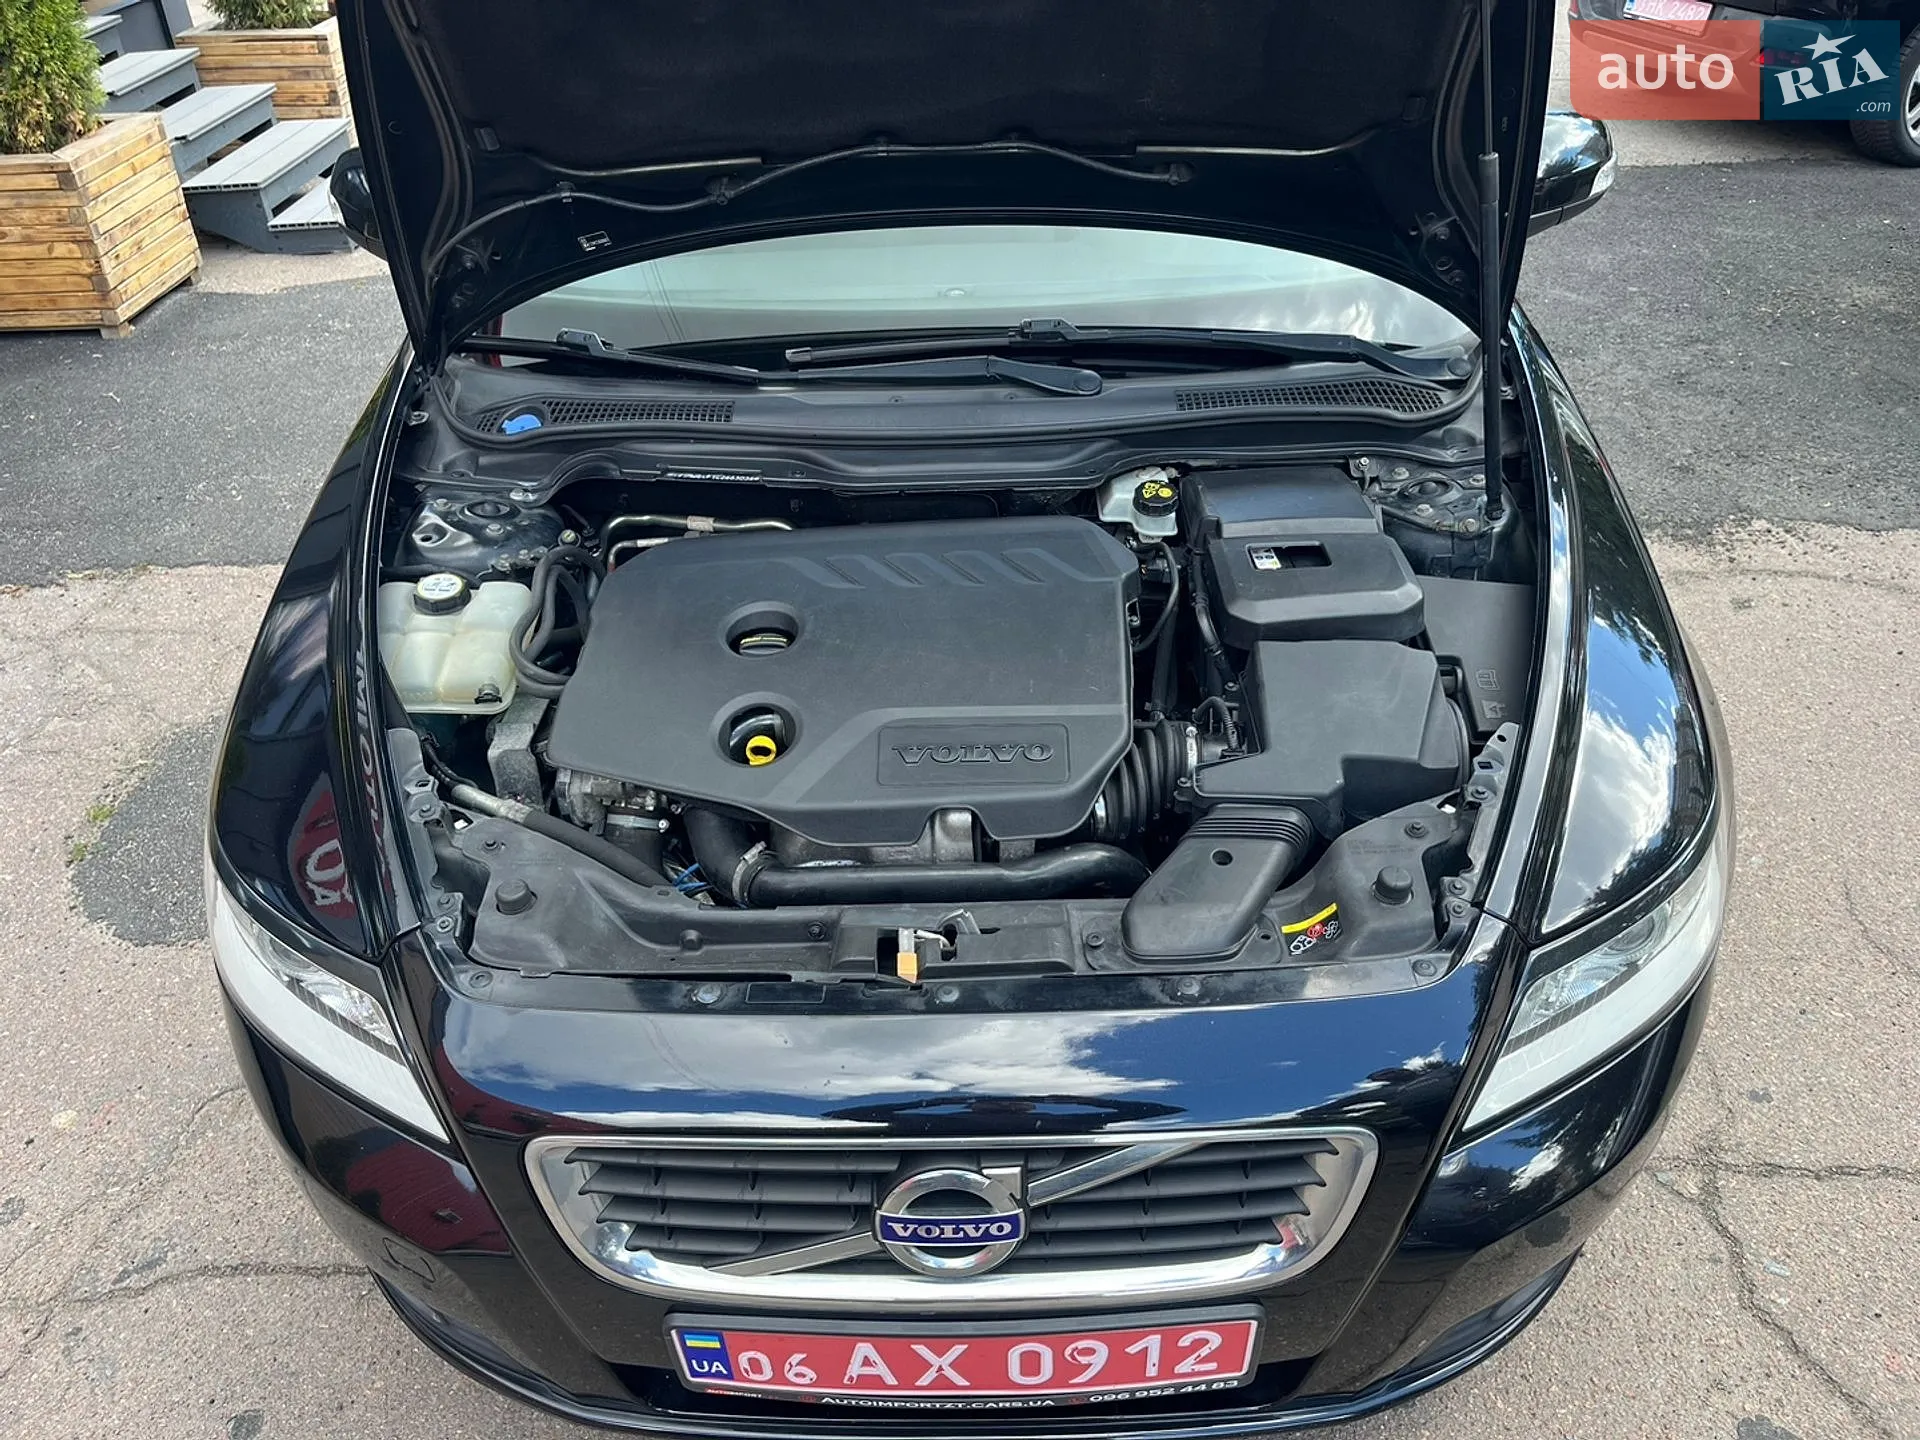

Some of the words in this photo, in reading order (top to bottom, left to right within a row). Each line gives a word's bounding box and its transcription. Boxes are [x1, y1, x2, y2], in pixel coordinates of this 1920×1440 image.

[892, 743, 1053, 763] VOLVO
[886, 1221, 1012, 1239] VOLVO
[691, 1360, 728, 1375] UA
[736, 1351, 818, 1386] 06
[844, 1341, 972, 1387] AX
[1006, 1331, 1224, 1386] 0912
[1089, 1393, 1130, 1402] 096
[1180, 1383, 1208, 1393] 44
